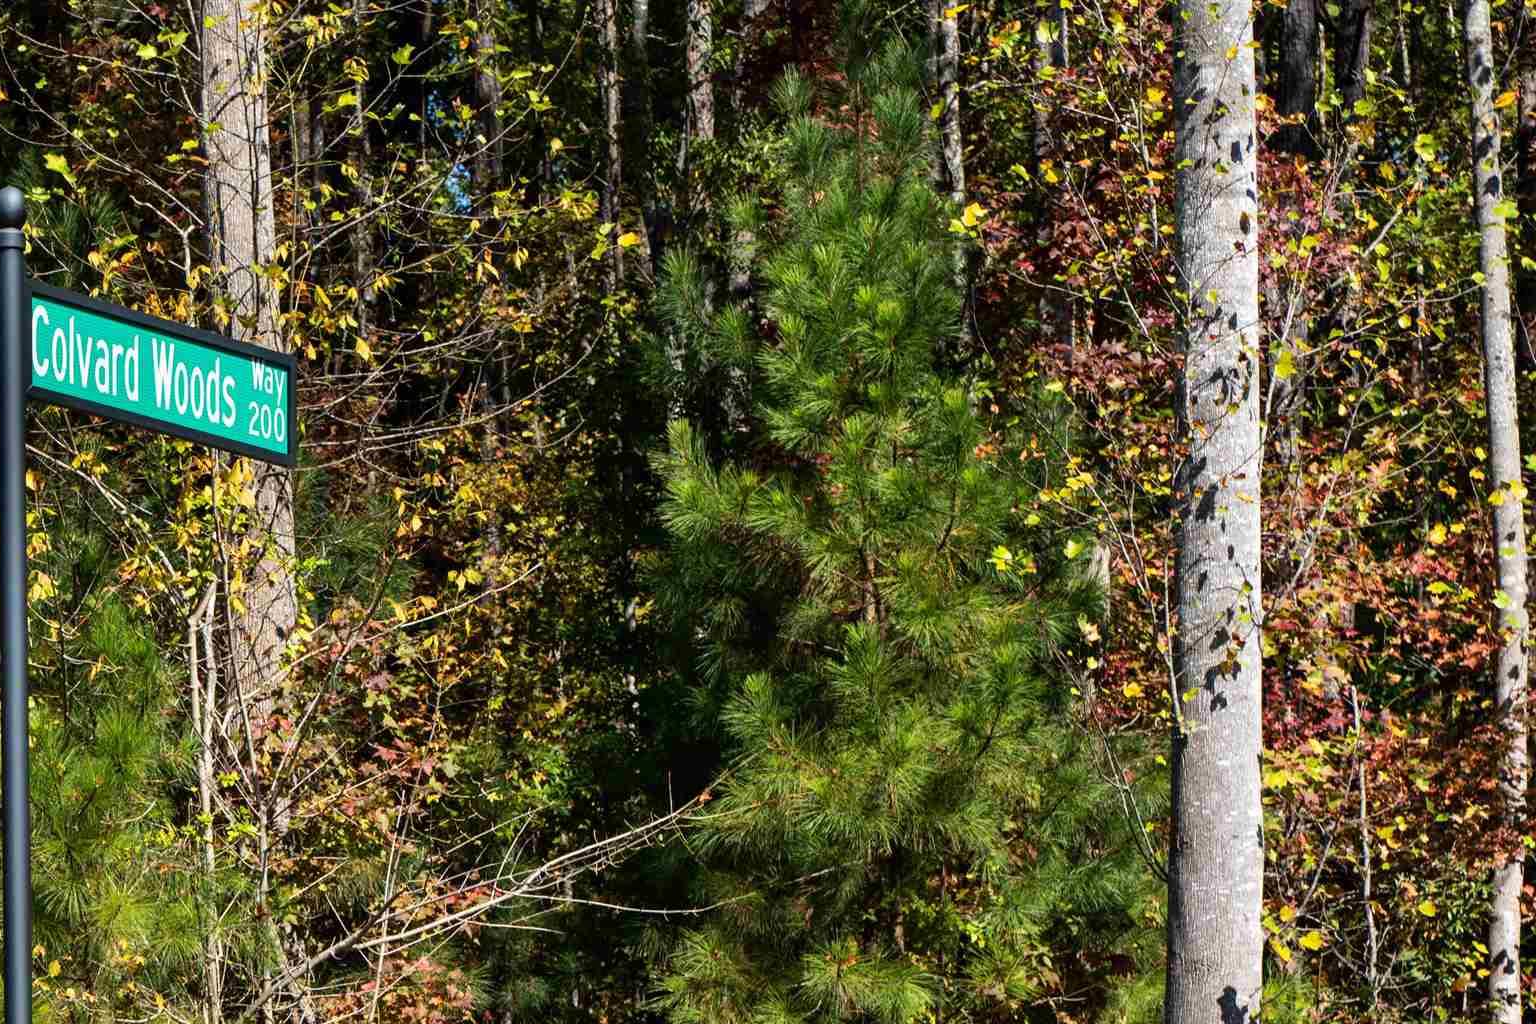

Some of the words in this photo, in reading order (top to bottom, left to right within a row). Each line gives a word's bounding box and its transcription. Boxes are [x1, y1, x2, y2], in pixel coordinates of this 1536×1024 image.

[31, 304, 140, 402] Colvard
[152, 337, 237, 428] Woods
[251, 358, 286, 408] Way
[247, 401, 286, 443] 200
